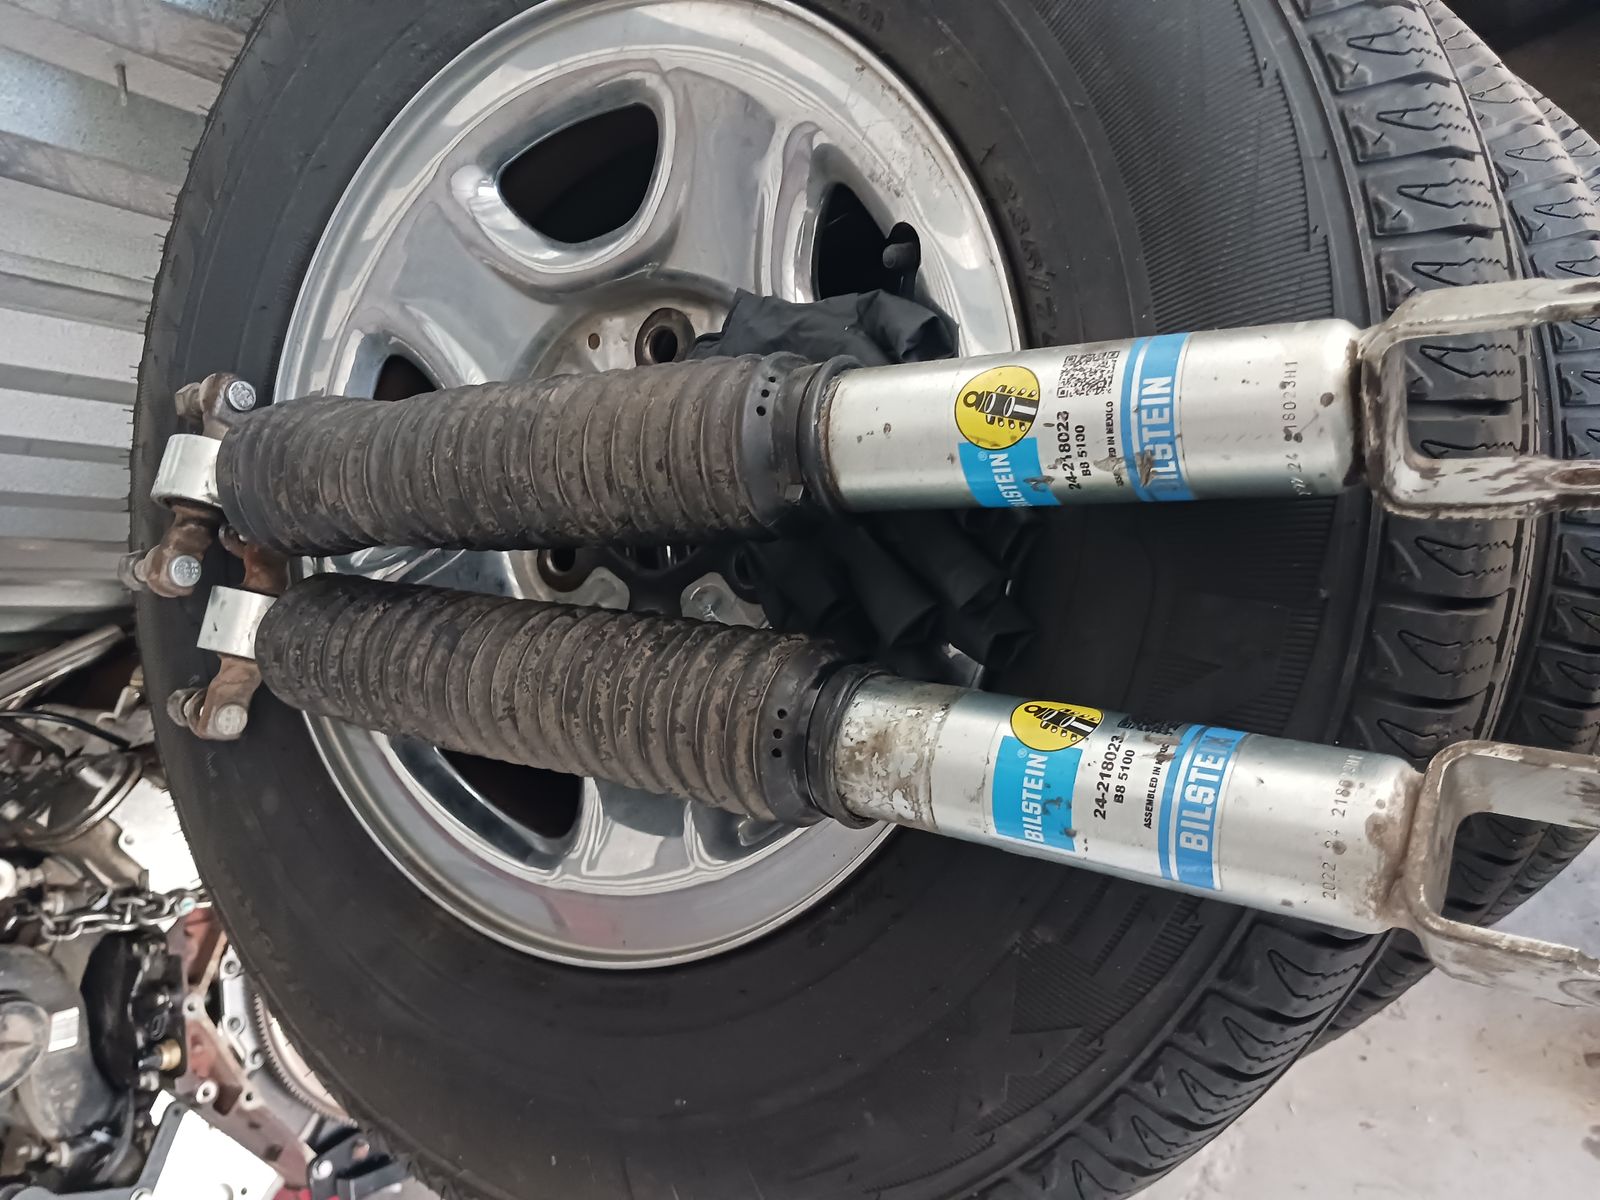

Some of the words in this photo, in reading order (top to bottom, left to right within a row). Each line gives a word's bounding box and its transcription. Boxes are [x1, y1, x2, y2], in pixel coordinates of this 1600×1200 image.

[1282, 361, 1302, 443] 18023H1
[1074, 425, 1088, 458] 5100
[1106, 436, 1115, 446] IN
[1140, 376, 1180, 487] ILSTEIN
[1080, 461, 1092, 477] B8
[1094, 735, 1124, 820] 24-218023
[1118, 749, 1135, 781] 5100
[1022, 753, 1048, 843] BILSTEIN
[1114, 785, 1126, 804] B8
[1144, 777, 1158, 829] ASSEMBLED
[1152, 766, 1161, 776] IN
[1179, 734, 1235, 852] BILSTEIN
[1322, 862, 1337, 900] 2022
